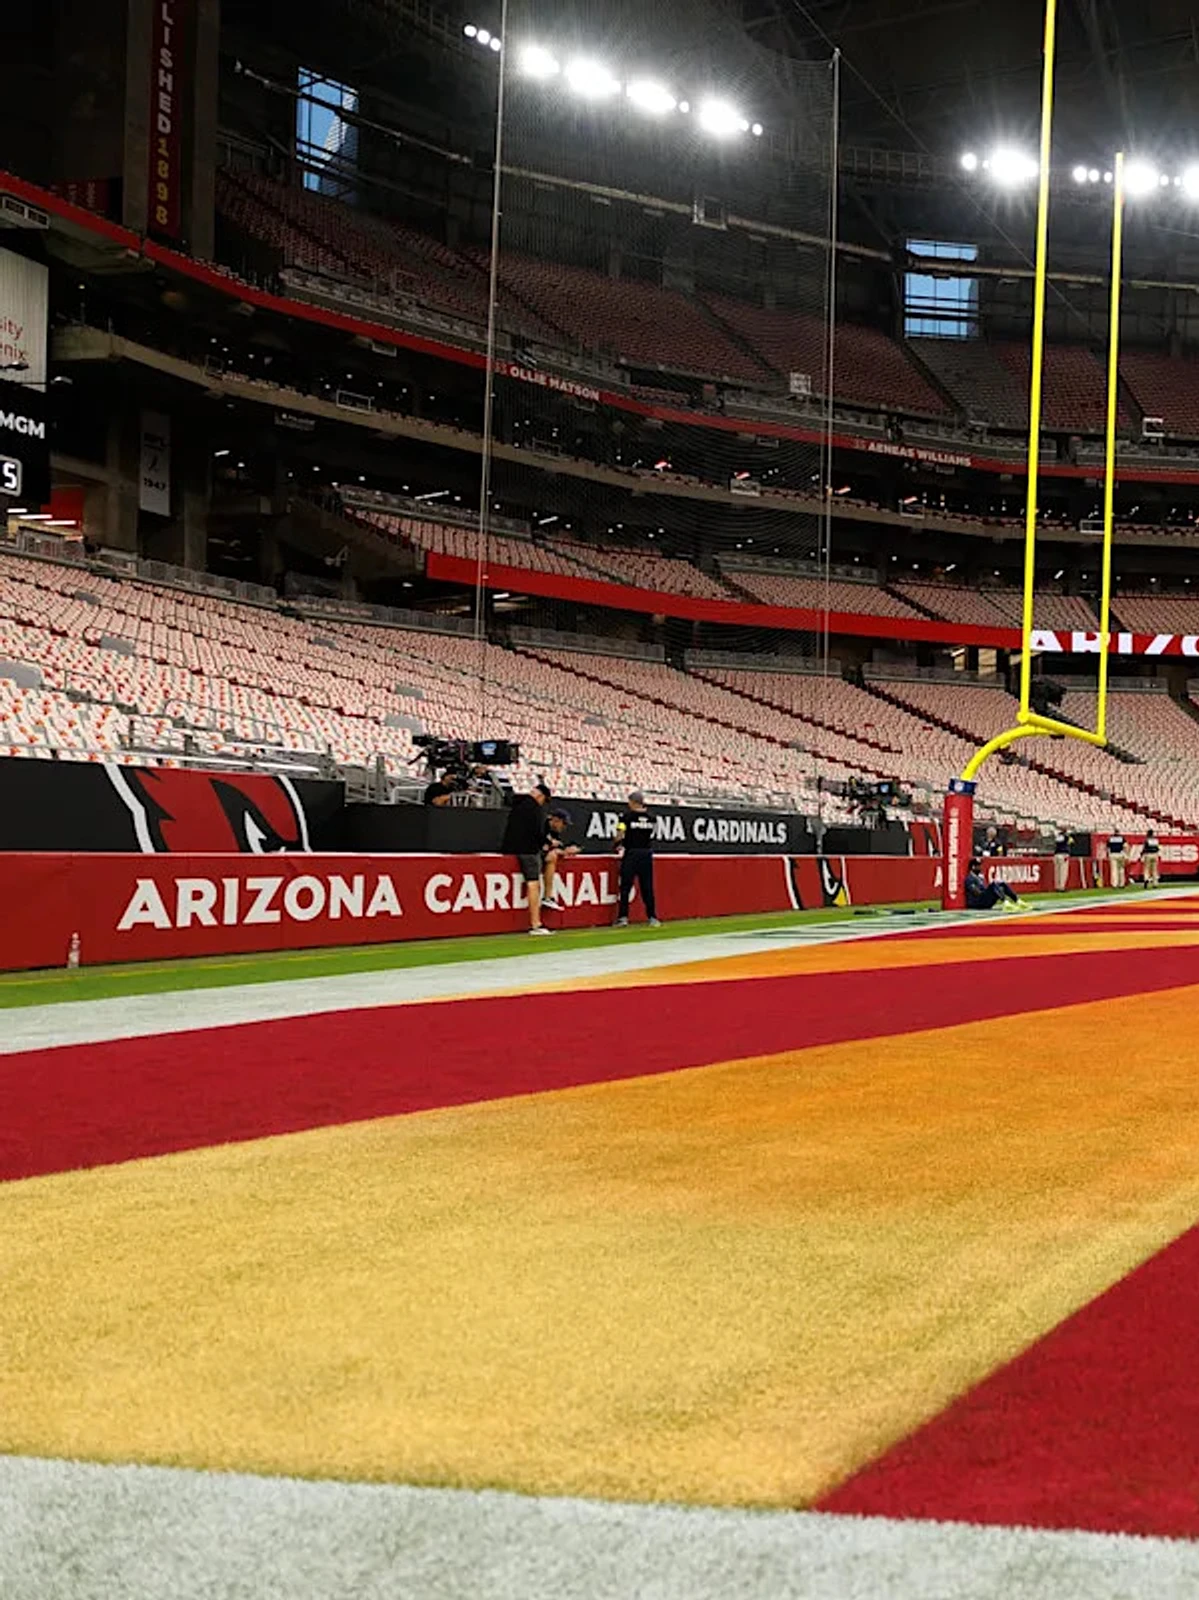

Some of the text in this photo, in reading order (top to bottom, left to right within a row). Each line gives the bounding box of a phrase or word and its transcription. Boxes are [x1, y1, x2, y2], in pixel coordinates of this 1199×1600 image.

[158, 0, 174, 134] LISHED
[156, 137, 169, 225] 1898
[510, 366, 547, 386] OLLIE
[549, 378, 600, 401] MATSON
[868, 442, 915, 458] AENEAS
[917, 449, 971, 467] WILLIAMS
[586, 811, 685, 841] ARNA
[692, 818, 787, 844] CARDINALS
[988, 865, 1040, 884] CARDINALS
[116, 872, 636, 931] ARIZONA CARDNAL
